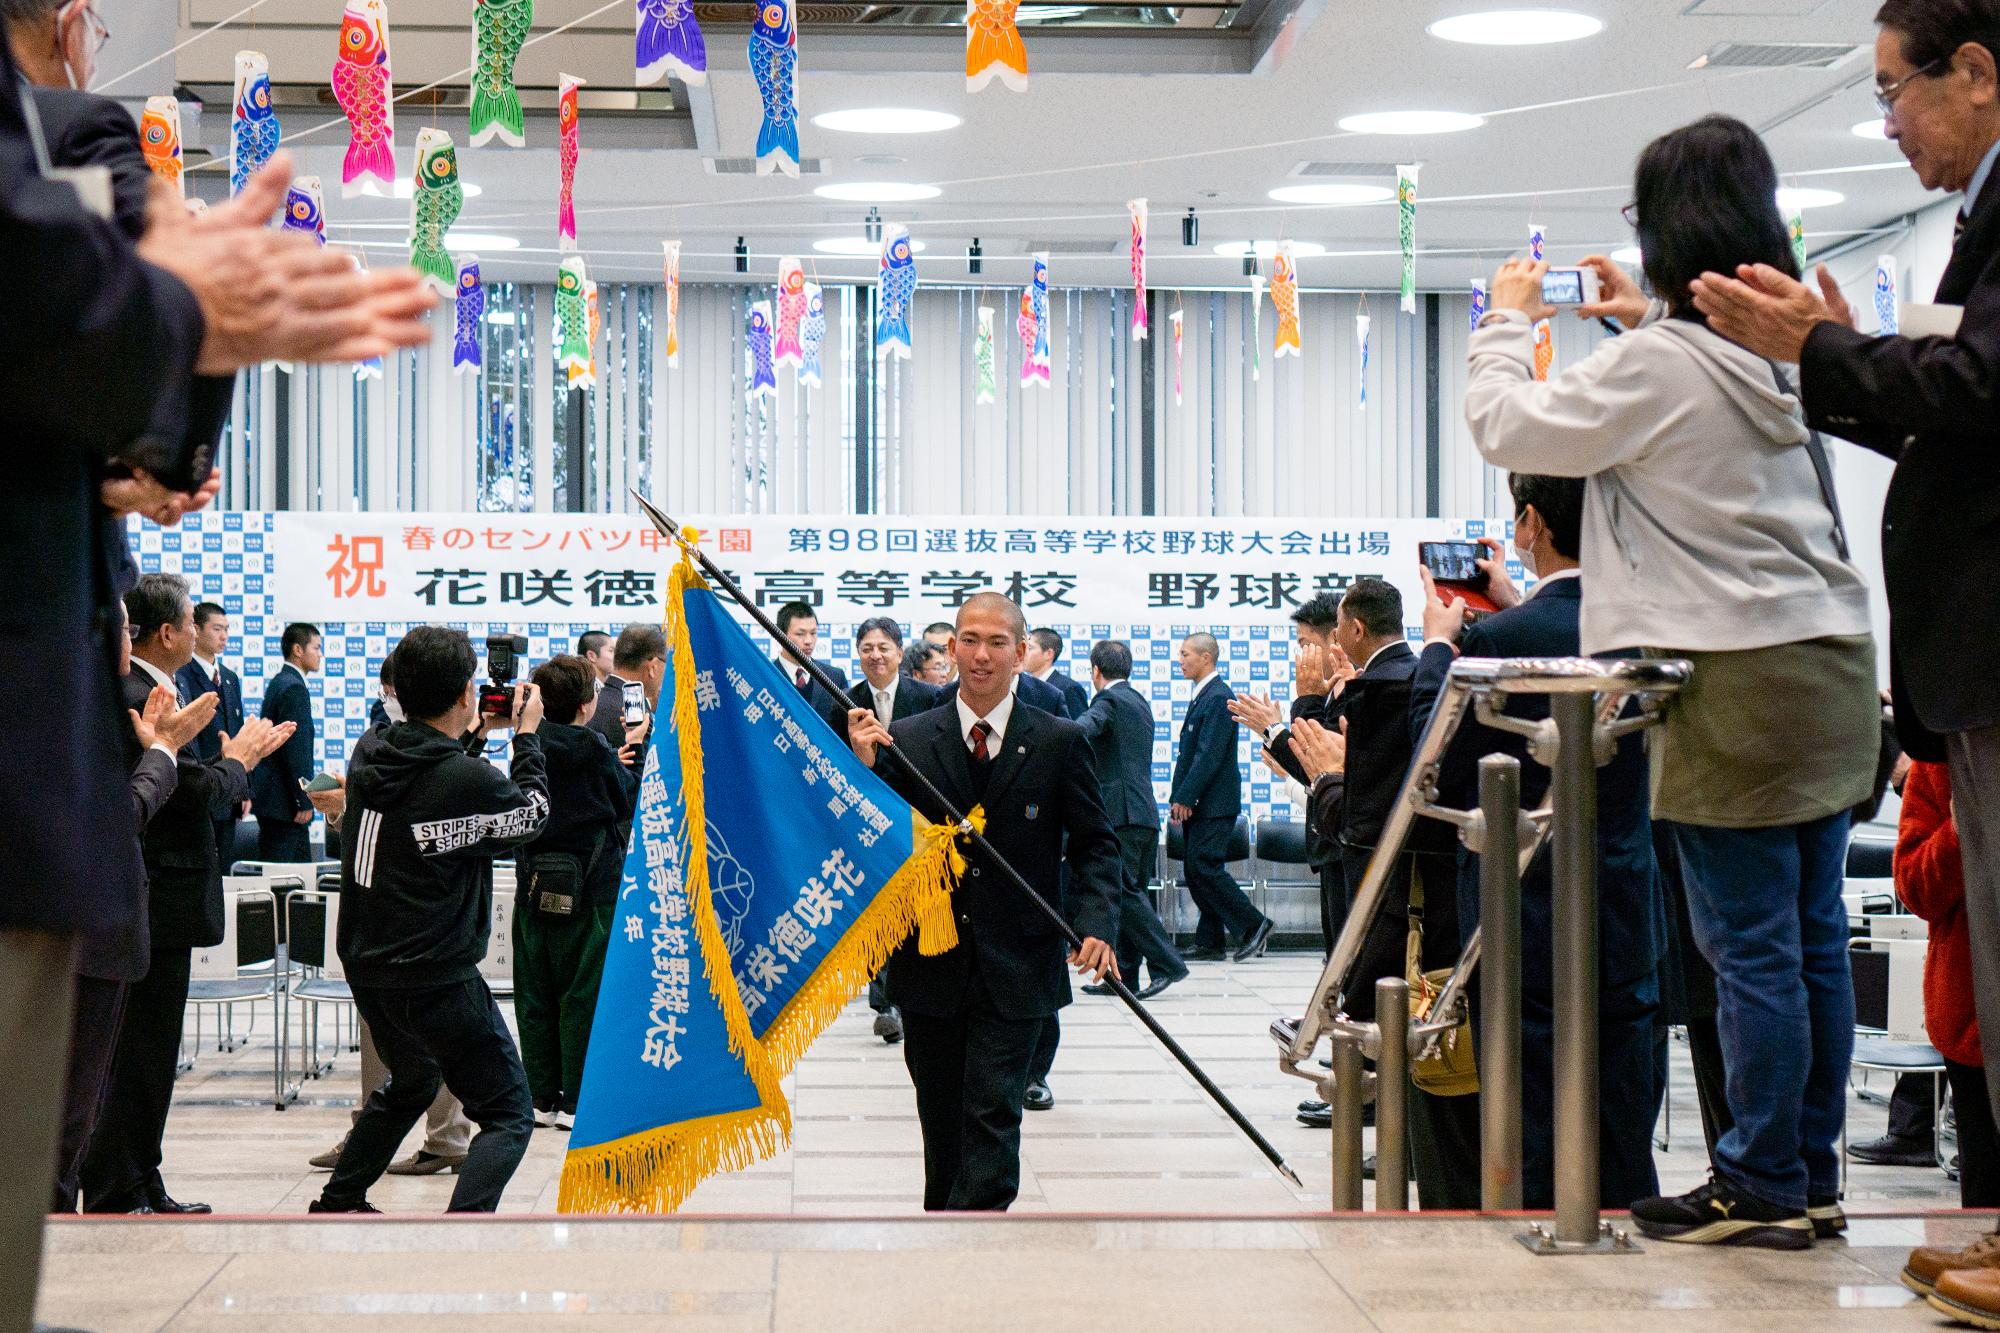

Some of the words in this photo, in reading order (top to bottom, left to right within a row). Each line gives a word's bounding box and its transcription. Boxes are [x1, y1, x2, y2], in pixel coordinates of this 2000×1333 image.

[787, 527, 1392, 556] 第98回選抜高等学校野球大会出場
[327, 535, 386, 598] 祝
[756, 687, 894, 835] 日本高等学校野球連盟
[421, 815, 480, 838] STRIPES
